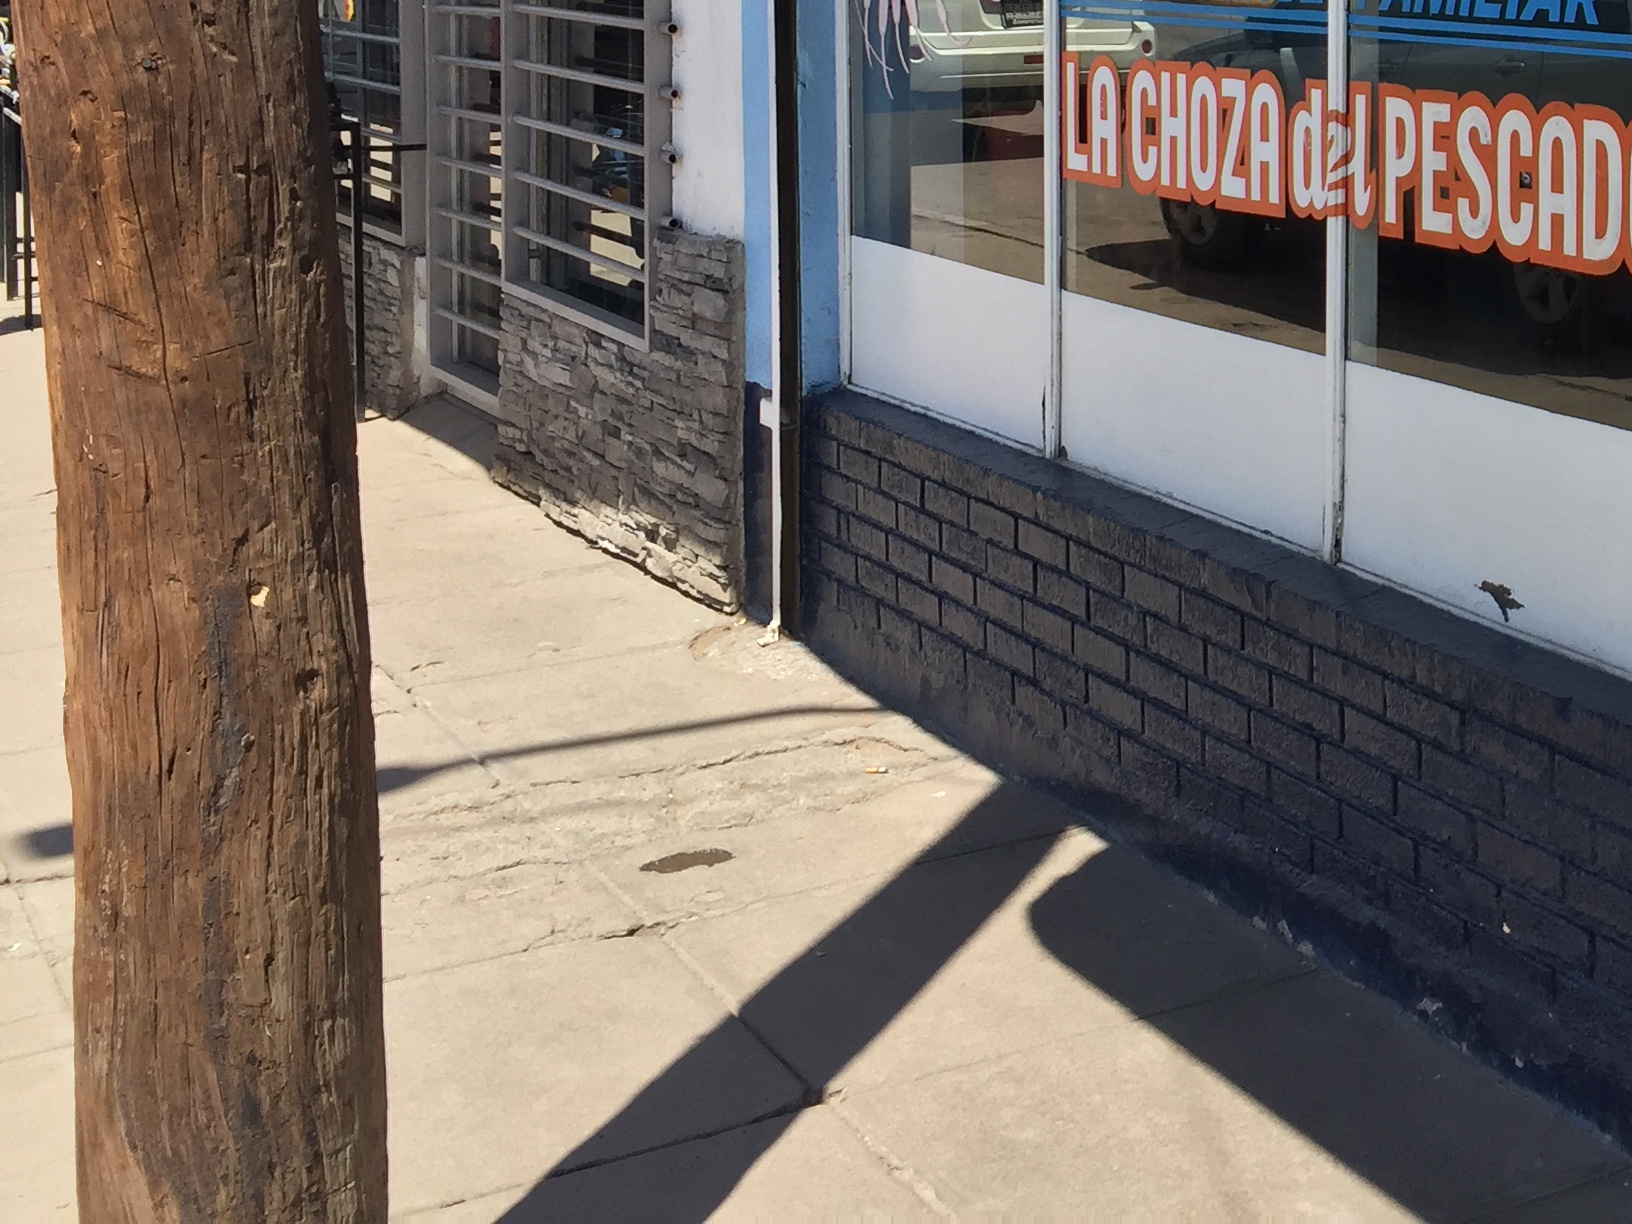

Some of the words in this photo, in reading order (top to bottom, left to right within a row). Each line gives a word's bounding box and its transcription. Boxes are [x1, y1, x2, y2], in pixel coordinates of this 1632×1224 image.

[1062, 52, 1122, 187] LA
[1125, 61, 1285, 218] CHOZA
[1288, 79, 1376, 229] del
